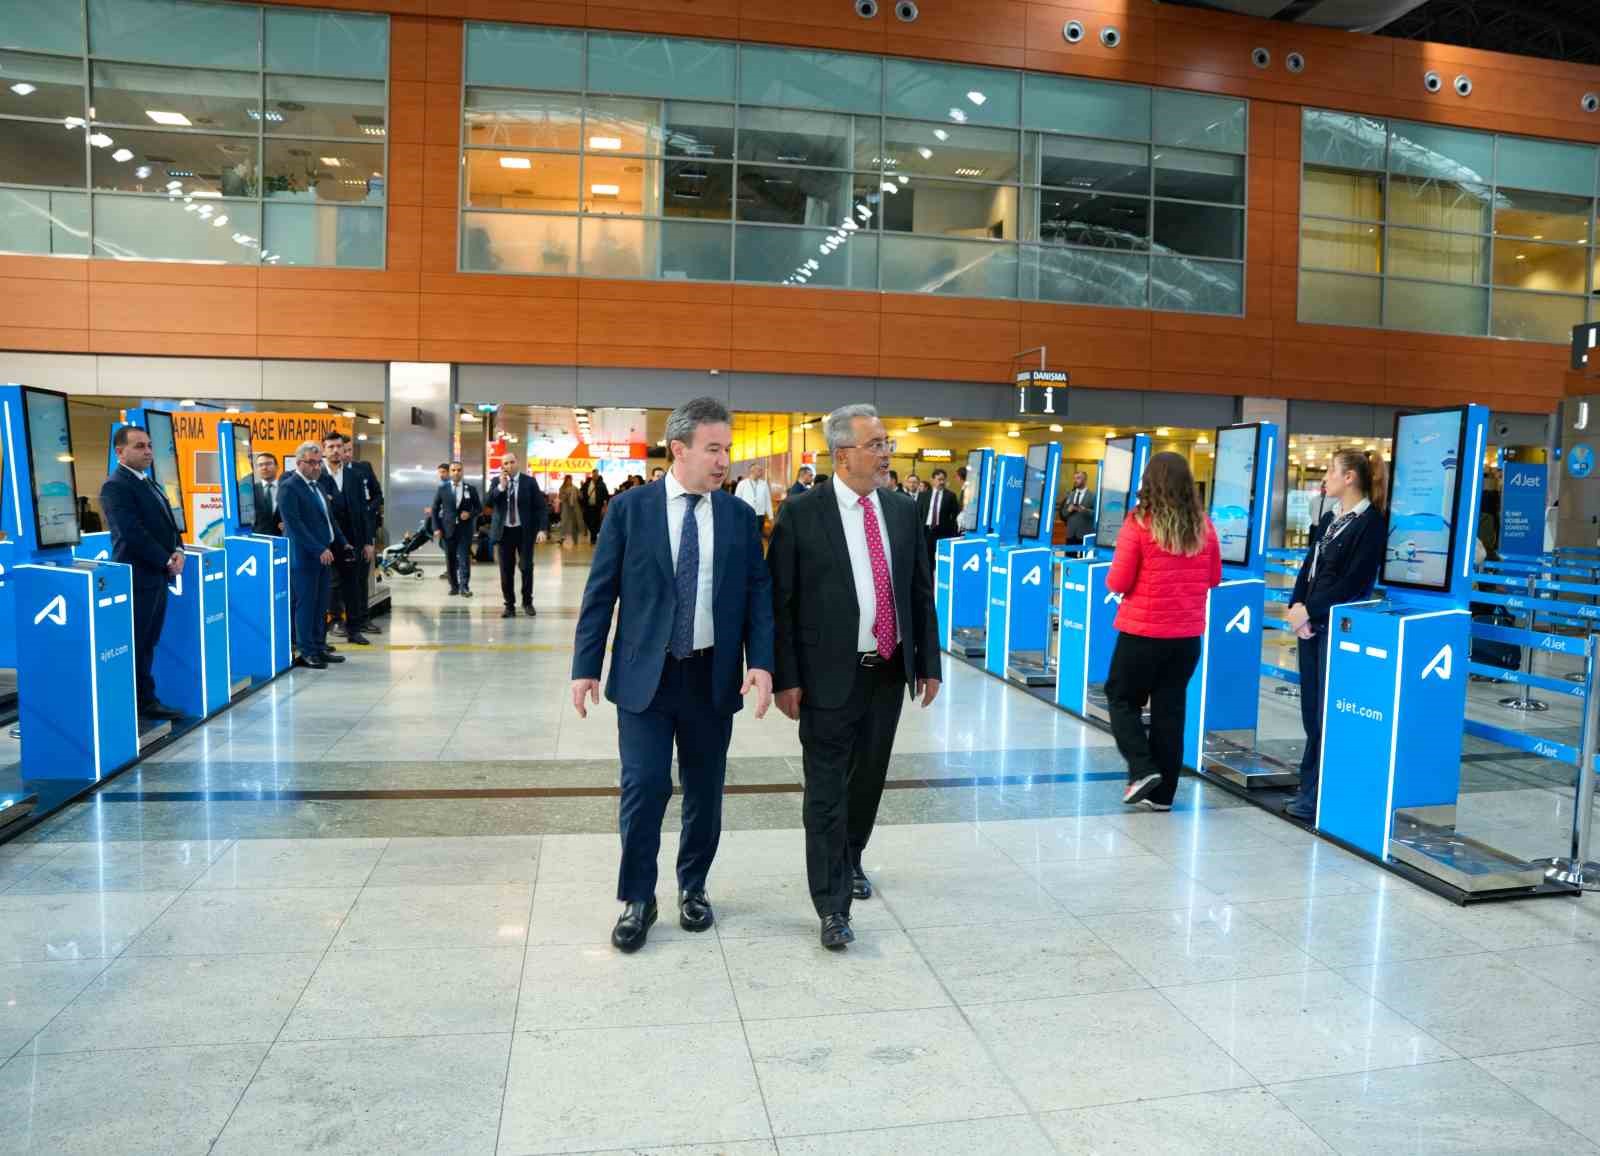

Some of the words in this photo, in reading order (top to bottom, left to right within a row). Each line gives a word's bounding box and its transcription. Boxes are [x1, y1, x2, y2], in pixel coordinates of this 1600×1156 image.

[1573, 402, 1588, 430] J
[1509, 472, 1541, 488] AJet
[1542, 637, 1568, 651] AJet
[1336, 698, 1384, 721] ajet.com
[1533, 743, 1558, 758] AJet
